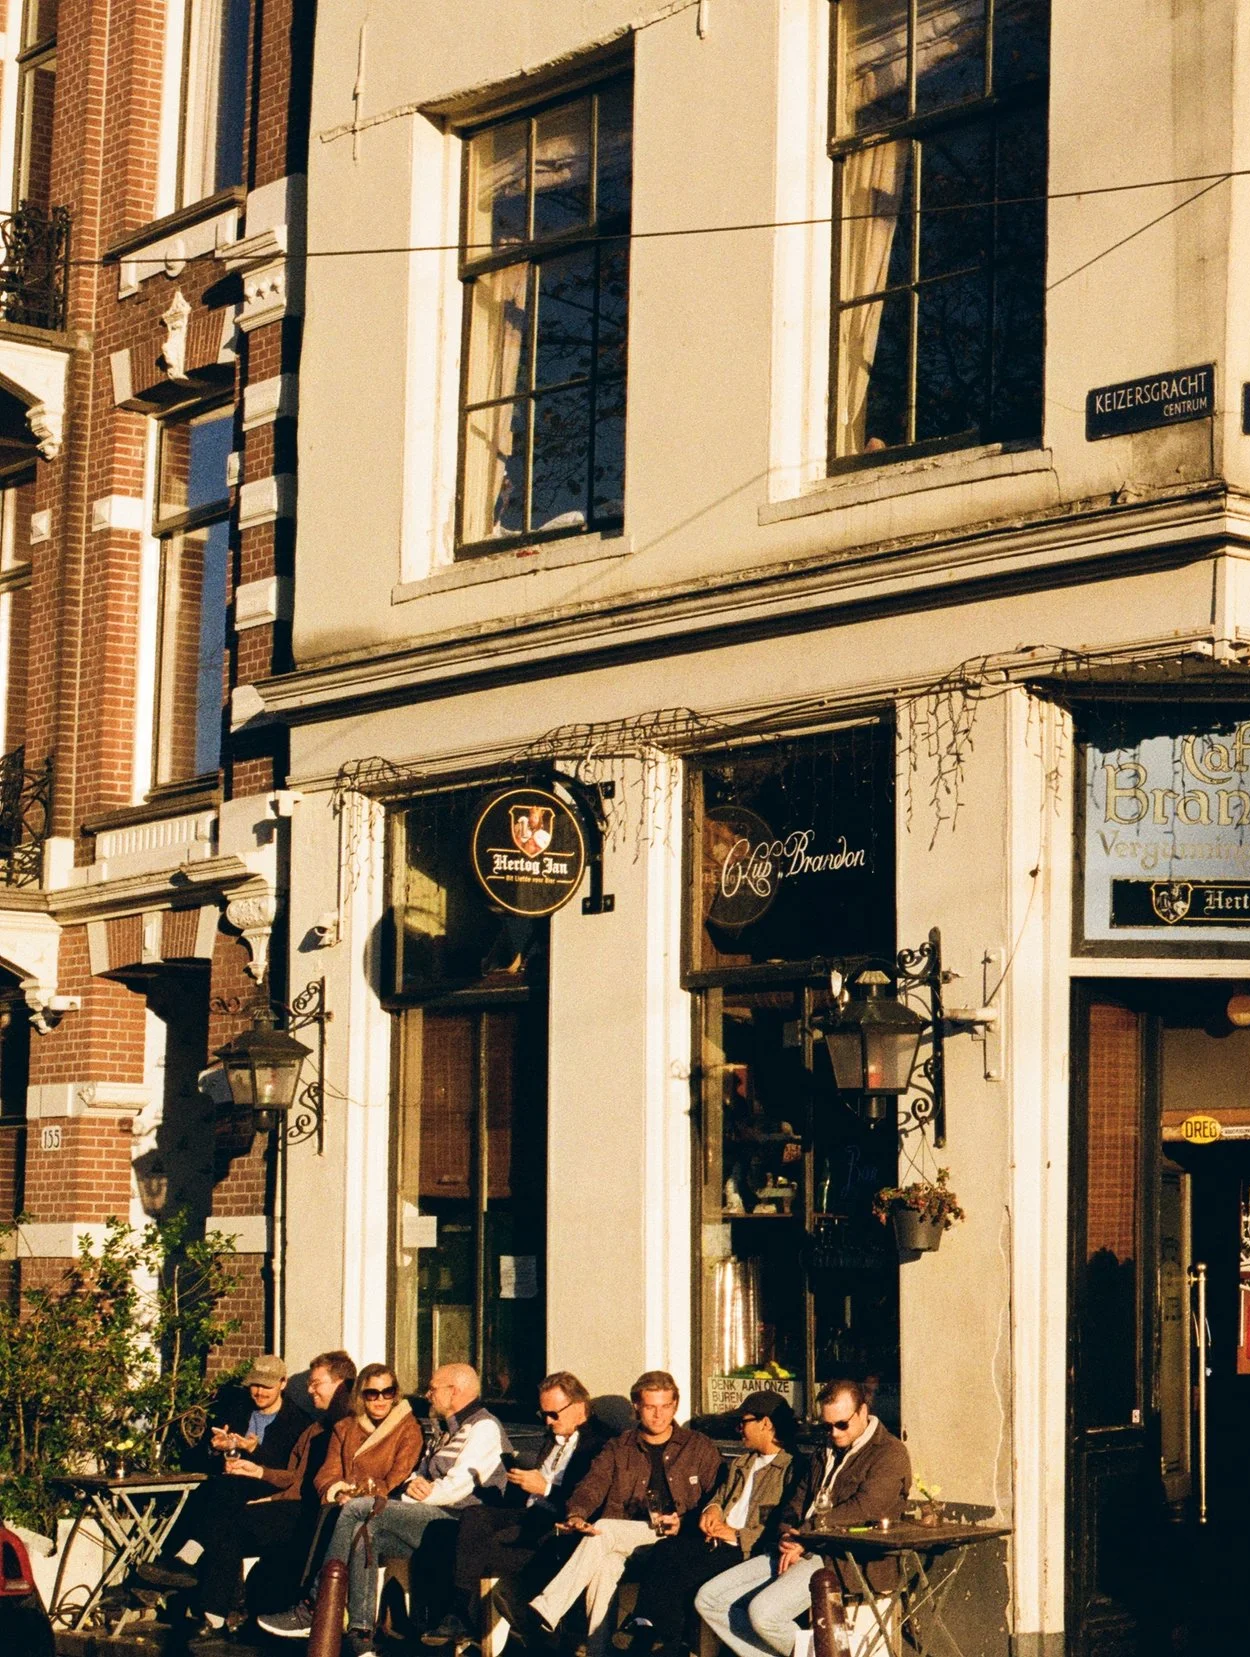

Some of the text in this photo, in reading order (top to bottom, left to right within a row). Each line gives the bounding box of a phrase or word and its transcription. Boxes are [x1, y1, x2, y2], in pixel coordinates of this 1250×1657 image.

[1095, 372, 1207, 415] KEIZERSGRACHT
[1163, 397, 1208, 417] CENTRUM
[492, 853, 568, 877] Hertog Jan
[44, 1129, 60, 1149] 155
[711, 1379, 790, 1393] DENK AAN ONZE
[712, 1391, 743, 1403] BUREN
